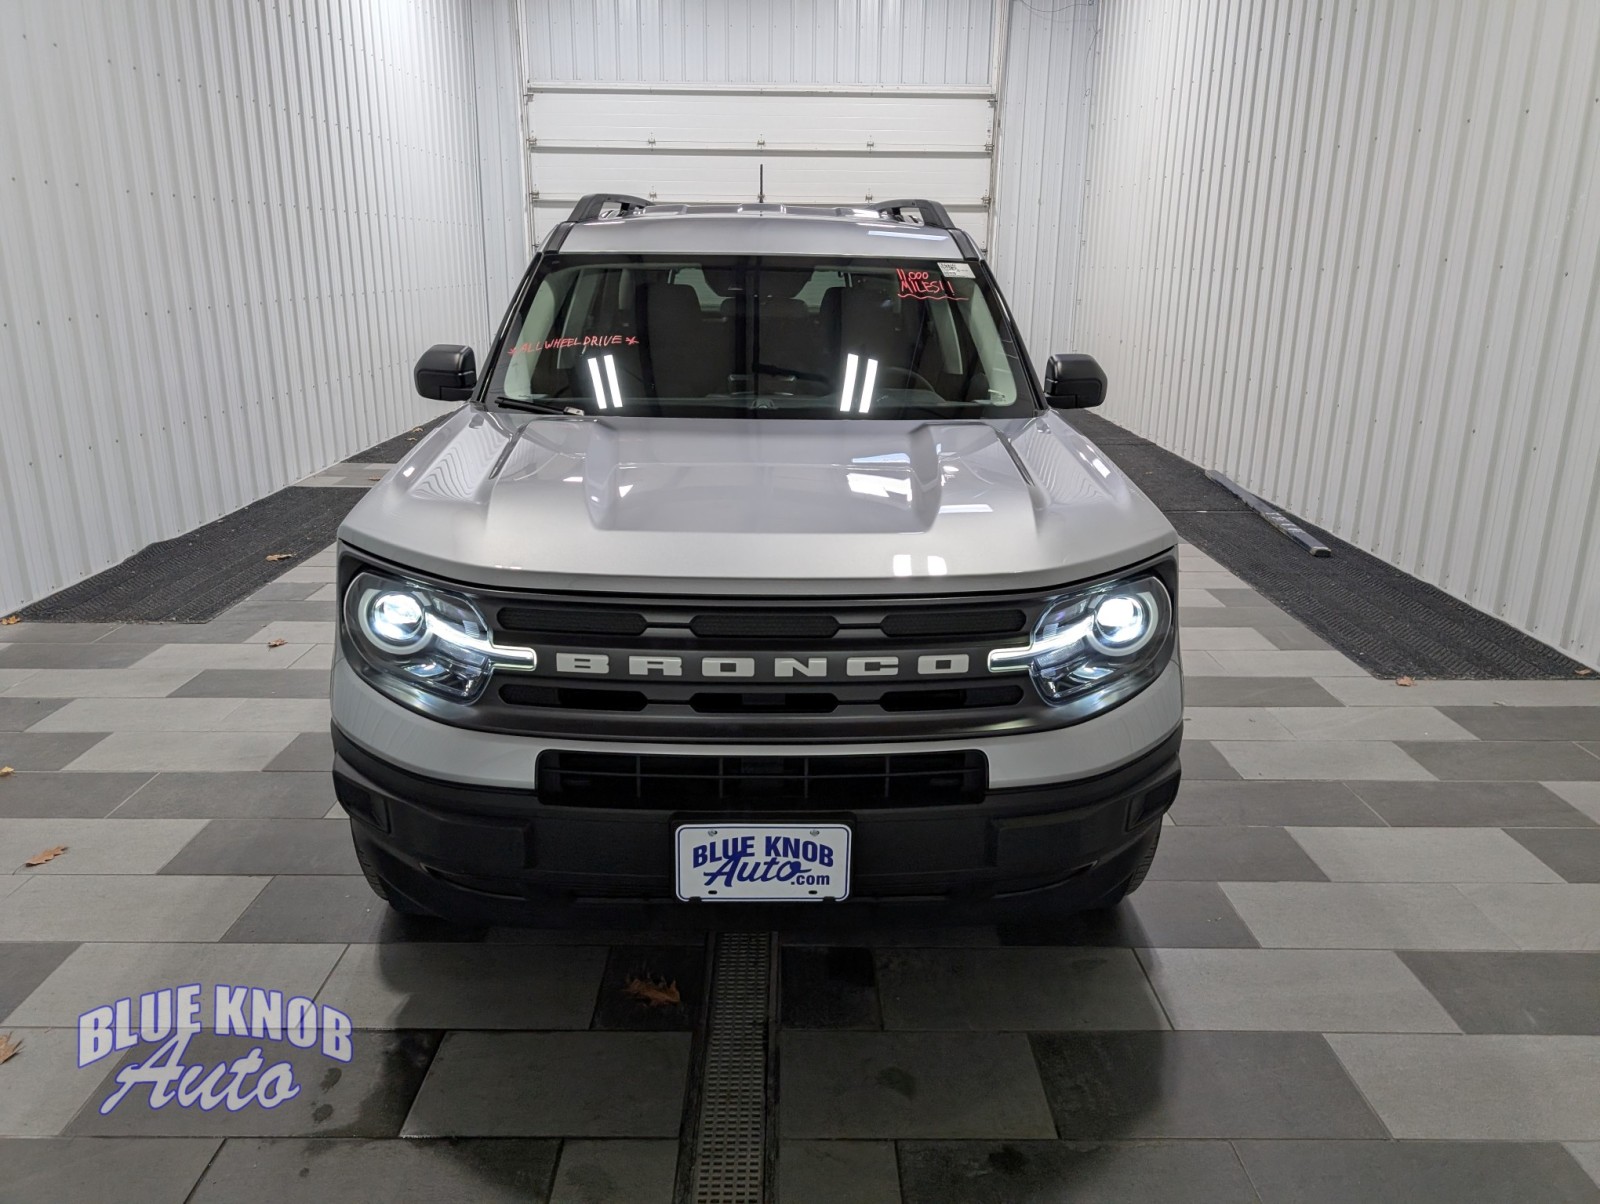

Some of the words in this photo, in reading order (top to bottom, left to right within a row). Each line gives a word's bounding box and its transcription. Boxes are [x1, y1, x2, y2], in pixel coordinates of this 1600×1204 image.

[521, 342, 542, 352] ALL
[544, 337, 581, 349] WHEEL
[584, 335, 622, 346] DRIVE
[555, 653, 970, 677] BRONCO
[693, 836, 755, 869] BLUE
[765, 836, 834, 868] KNOB
